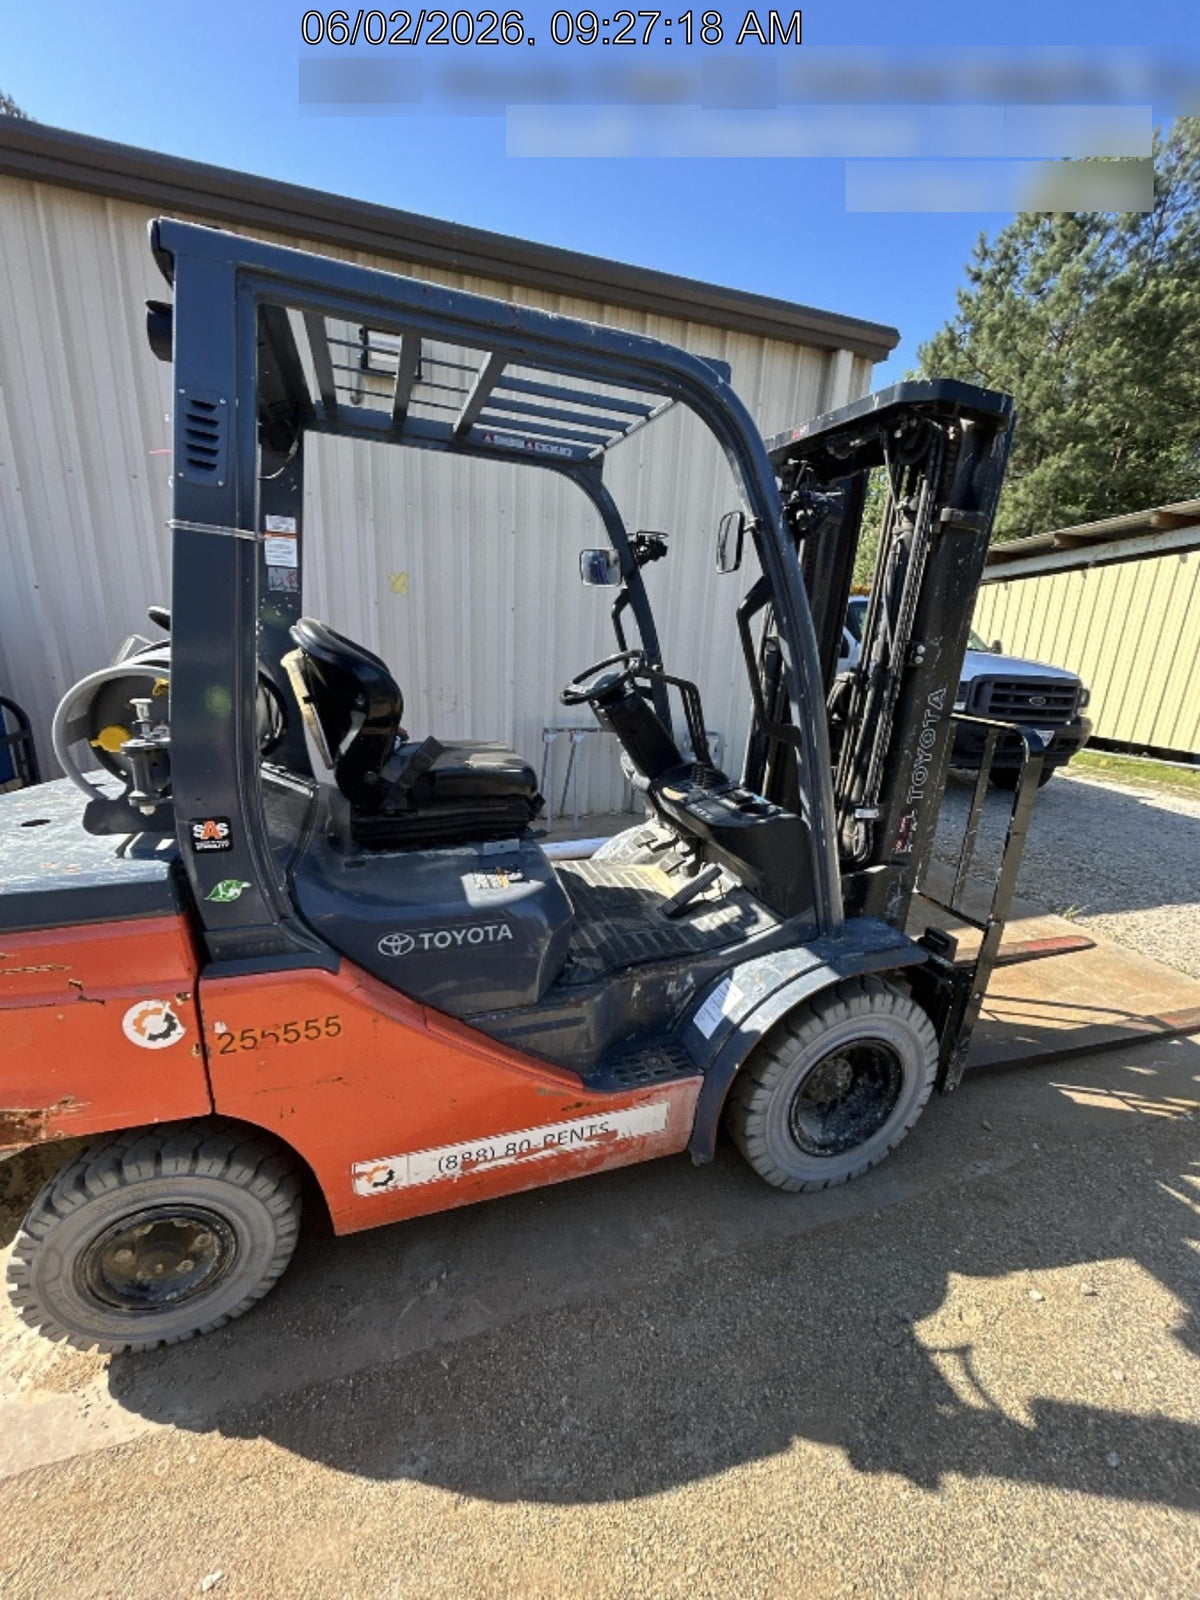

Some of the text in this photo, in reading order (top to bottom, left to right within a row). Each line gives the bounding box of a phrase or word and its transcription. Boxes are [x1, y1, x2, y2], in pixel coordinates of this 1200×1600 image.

[906, 687, 947, 805] TOYOTA
[192, 820, 229, 840] SAS
[418, 923, 513, 951] TOYOTA
